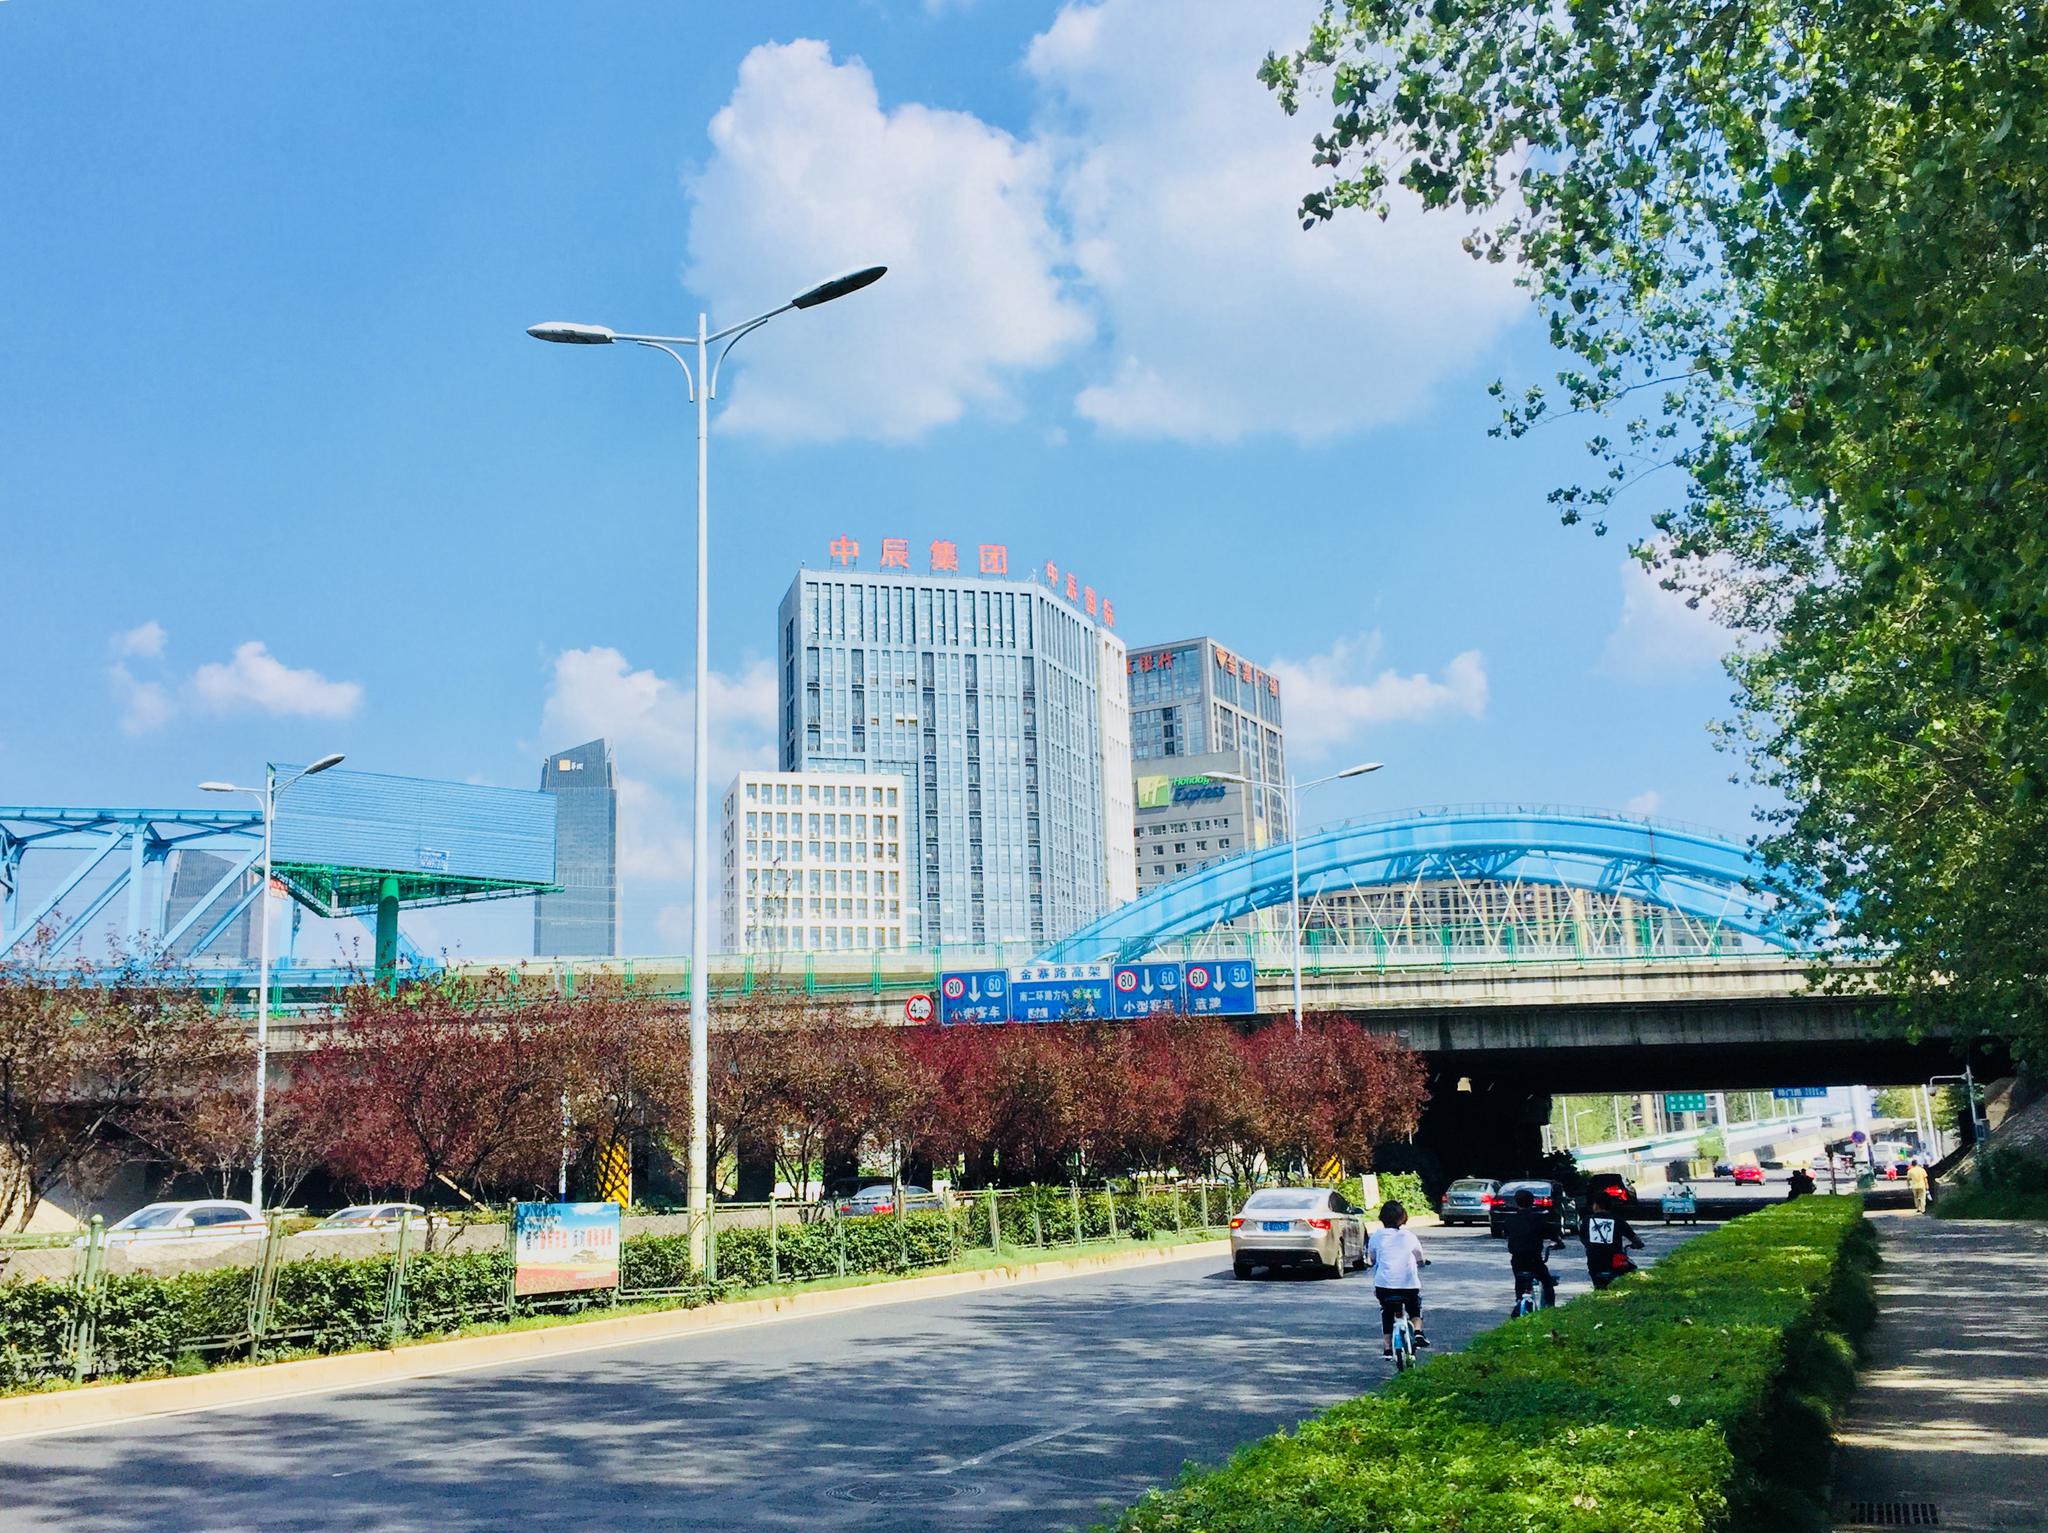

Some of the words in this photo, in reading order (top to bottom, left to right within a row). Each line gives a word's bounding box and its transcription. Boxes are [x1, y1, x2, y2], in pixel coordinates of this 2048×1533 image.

[830, 535, 1008, 575] 中辰集团
[1173, 786, 1226, 802] Express
[1020, 966, 1101, 980] 金寨路高架
[1161, 971, 1174, 985] 60
[1192, 971, 1205, 985] 60
[1233, 967, 1246, 982] 50
[948, 981, 961, 994] 80
[988, 978, 1001, 991] 60
[1120, 974, 1133, 988] 80
[910, 1003, 930, 1015] 4.5m
[950, 1005, 1001, 1020] 小型客车
[1123, 999, 1175, 1013] 小型客车
